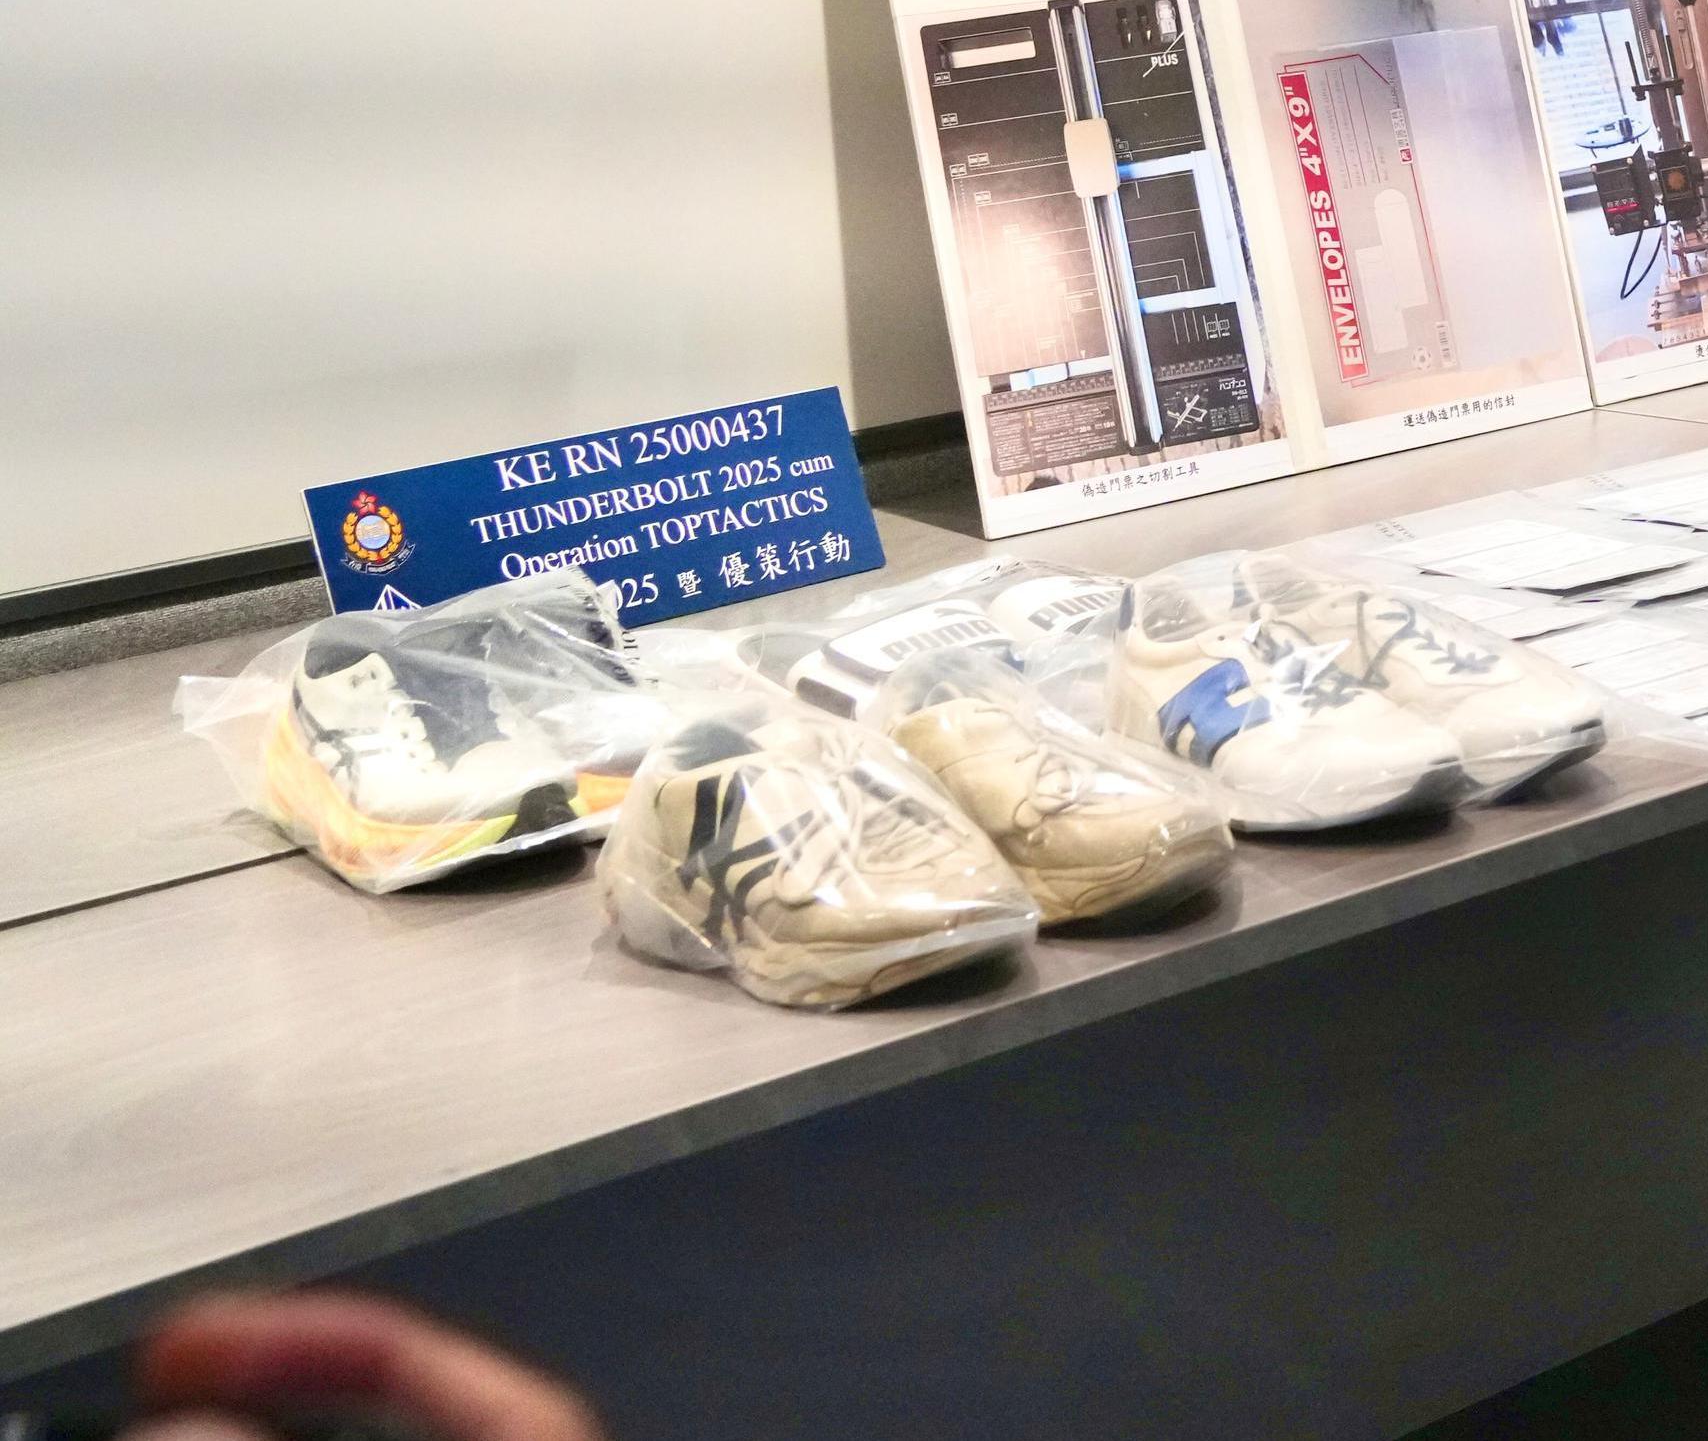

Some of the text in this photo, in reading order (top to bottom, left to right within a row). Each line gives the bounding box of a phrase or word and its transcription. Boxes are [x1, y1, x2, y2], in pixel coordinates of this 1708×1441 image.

[1150, 53, 1179, 67] PLUS
[1309, 190, 1364, 366] ENVELOPES
[494, 405, 785, 492] KE RN 25000437
[471, 452, 835, 546] THUNDERBOLT 2025 cum
[499, 486, 830, 584] Operation TOPTACTICS
[678, 570, 703, 599] 暨
[718, 533, 852, 590] 優策行動
[879, 619, 1001, 662] PUMA
